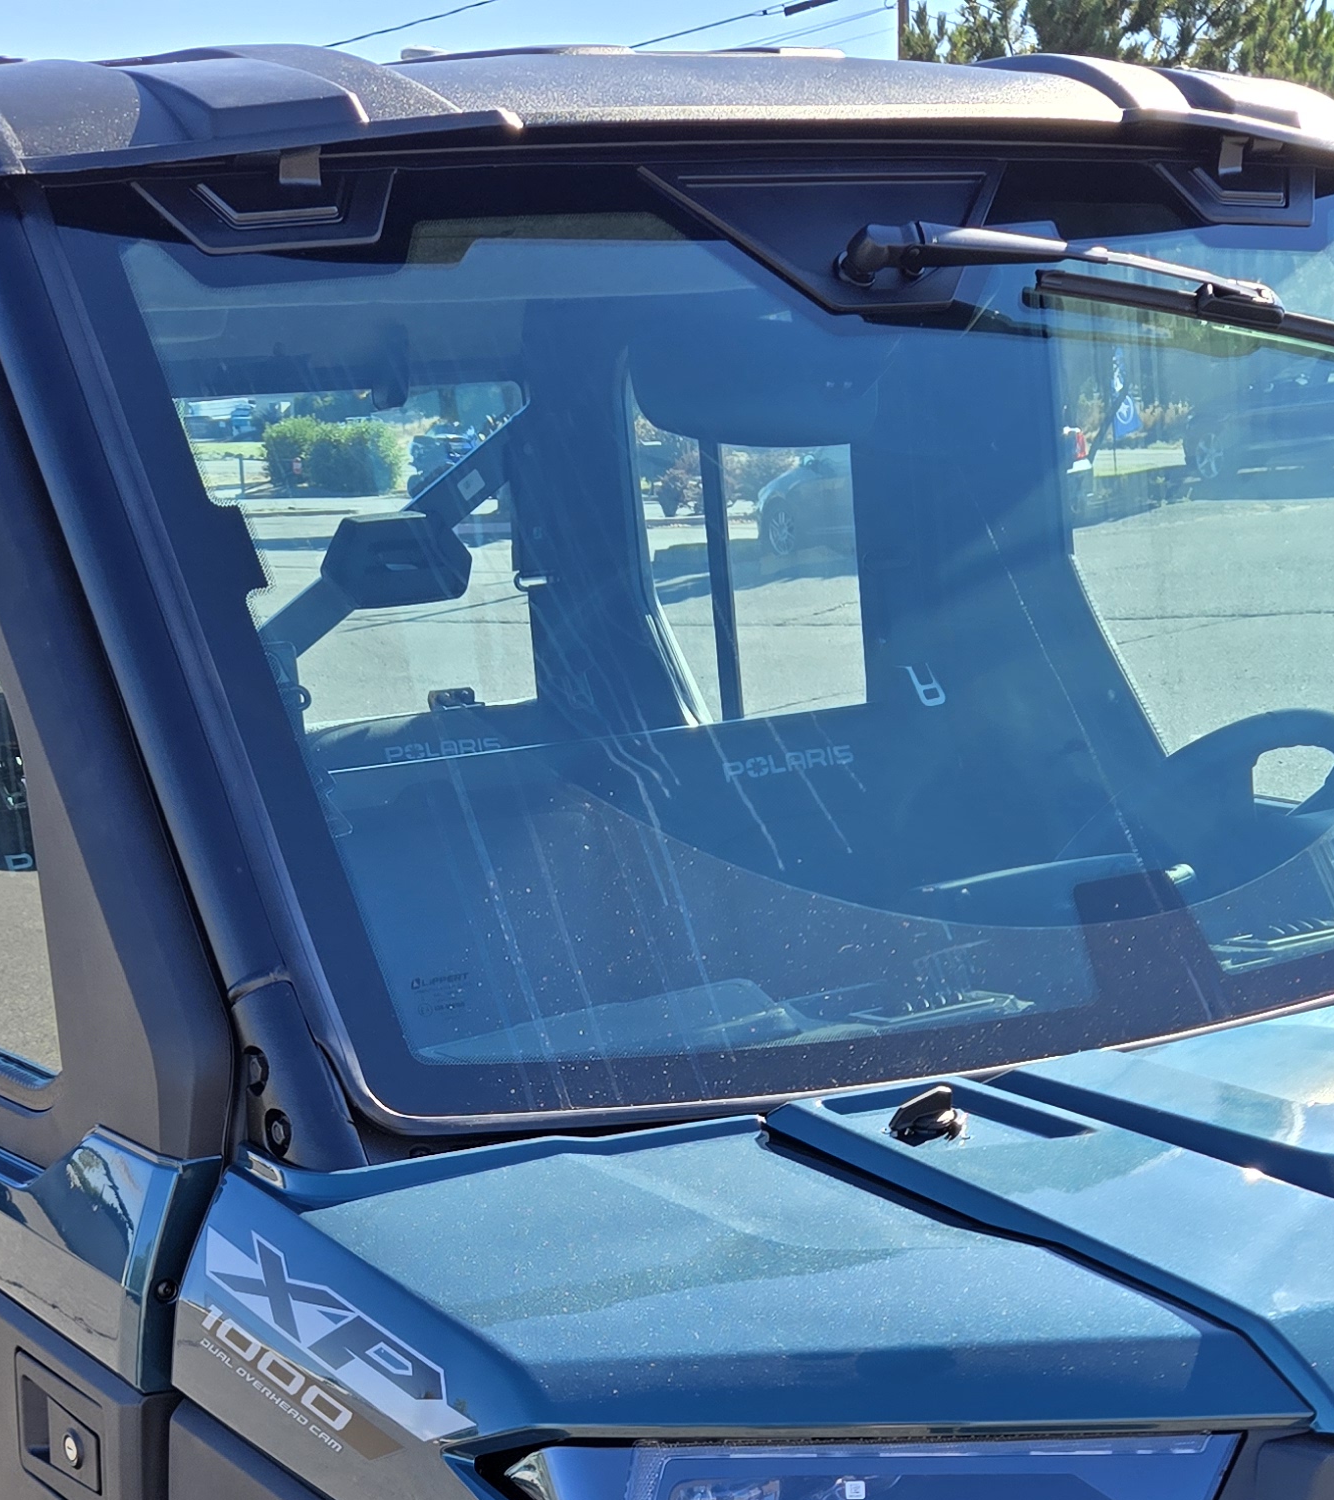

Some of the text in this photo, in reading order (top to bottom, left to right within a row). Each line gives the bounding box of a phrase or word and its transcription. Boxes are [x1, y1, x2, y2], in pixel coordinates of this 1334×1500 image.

[383, 737, 502, 762] POLARIS
[723, 744, 854, 783] POLARIS
[200, 1304, 353, 1431] 1000
[206, 1230, 447, 1400] XP
[199, 1337, 344, 1453] DUAL OVERHEAD CAM
